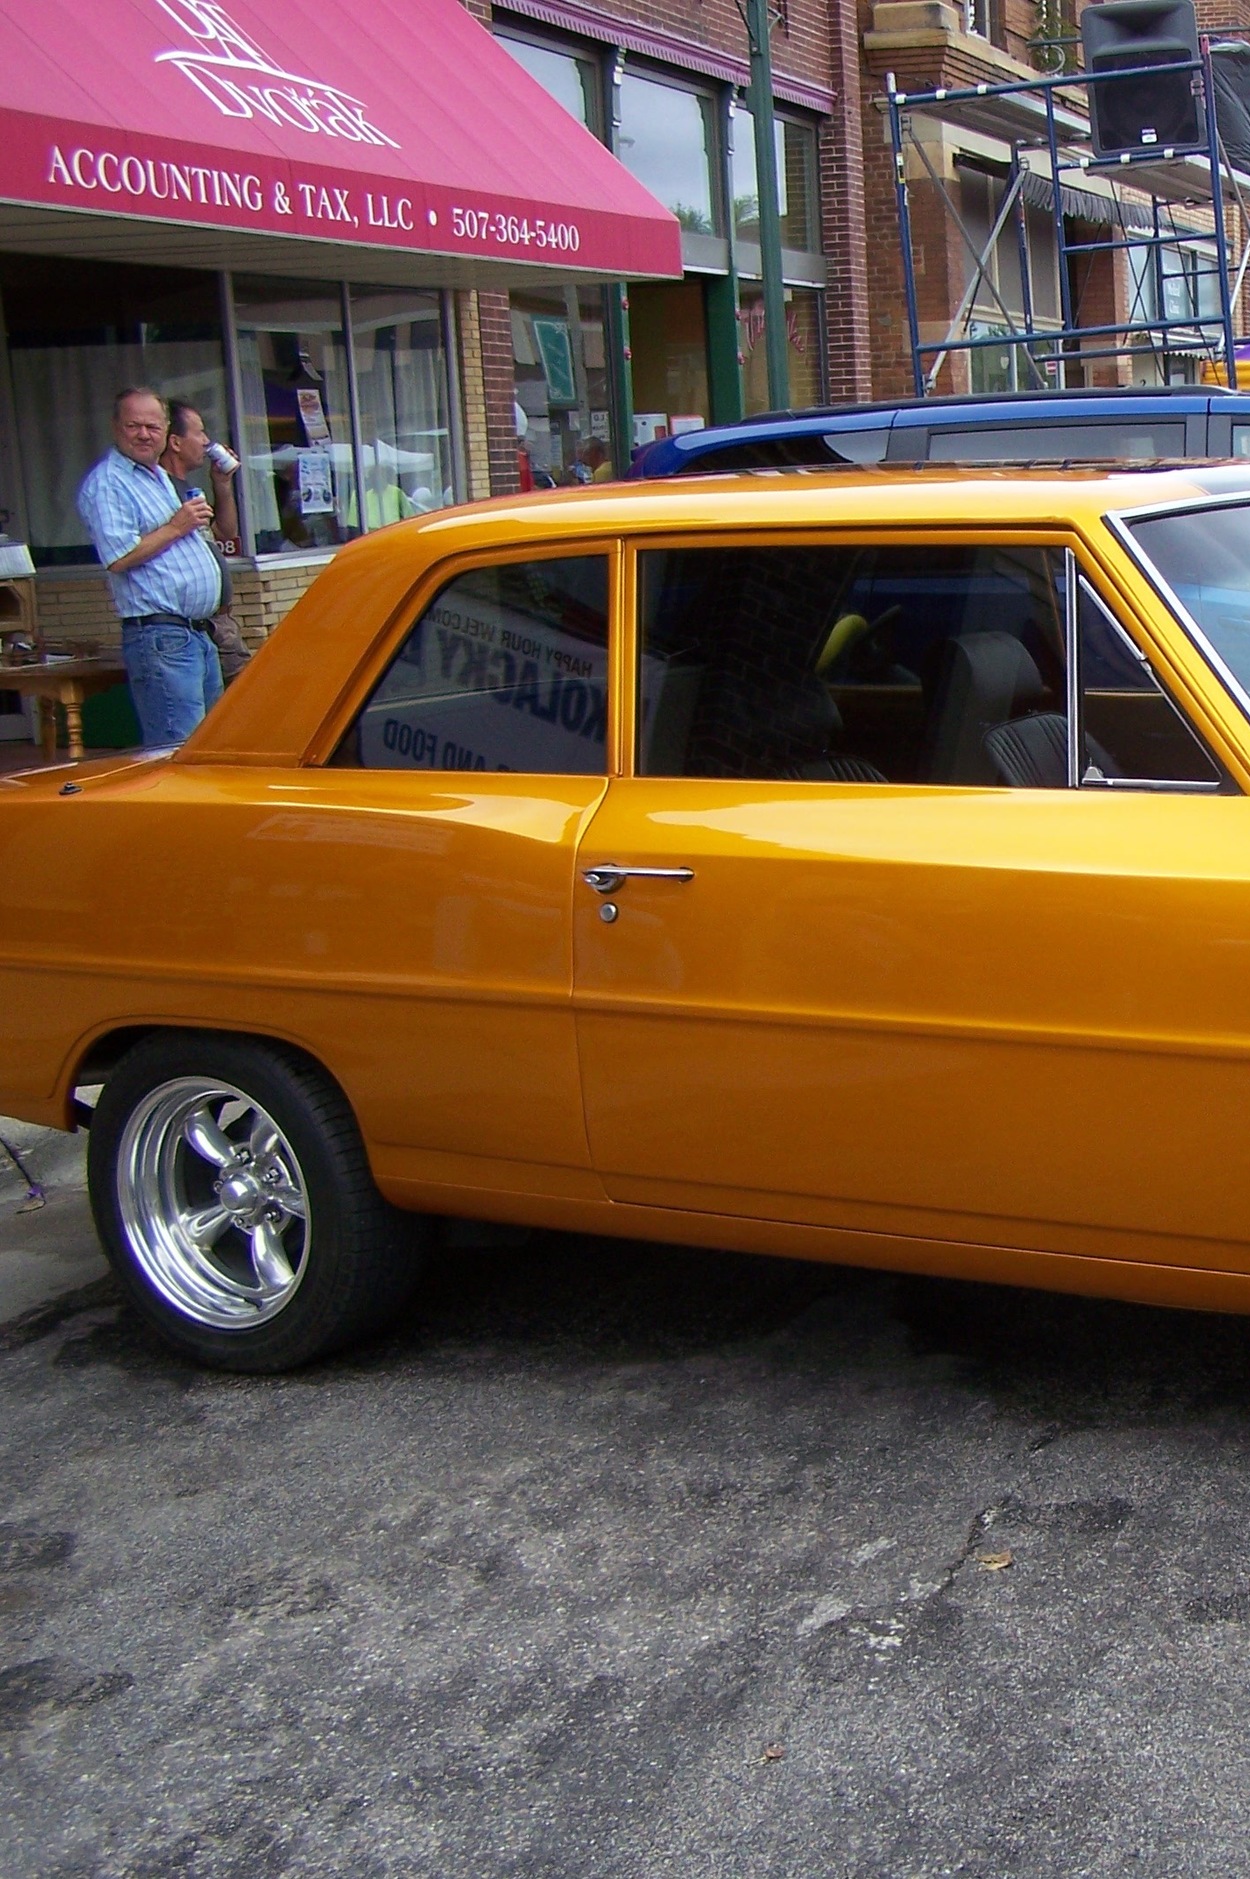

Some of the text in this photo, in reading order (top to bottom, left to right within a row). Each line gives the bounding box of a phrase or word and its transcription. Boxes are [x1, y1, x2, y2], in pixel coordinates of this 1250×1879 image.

[48, 145, 580, 251] ACCOUNTING & TAX, LLC 507-364-5400
